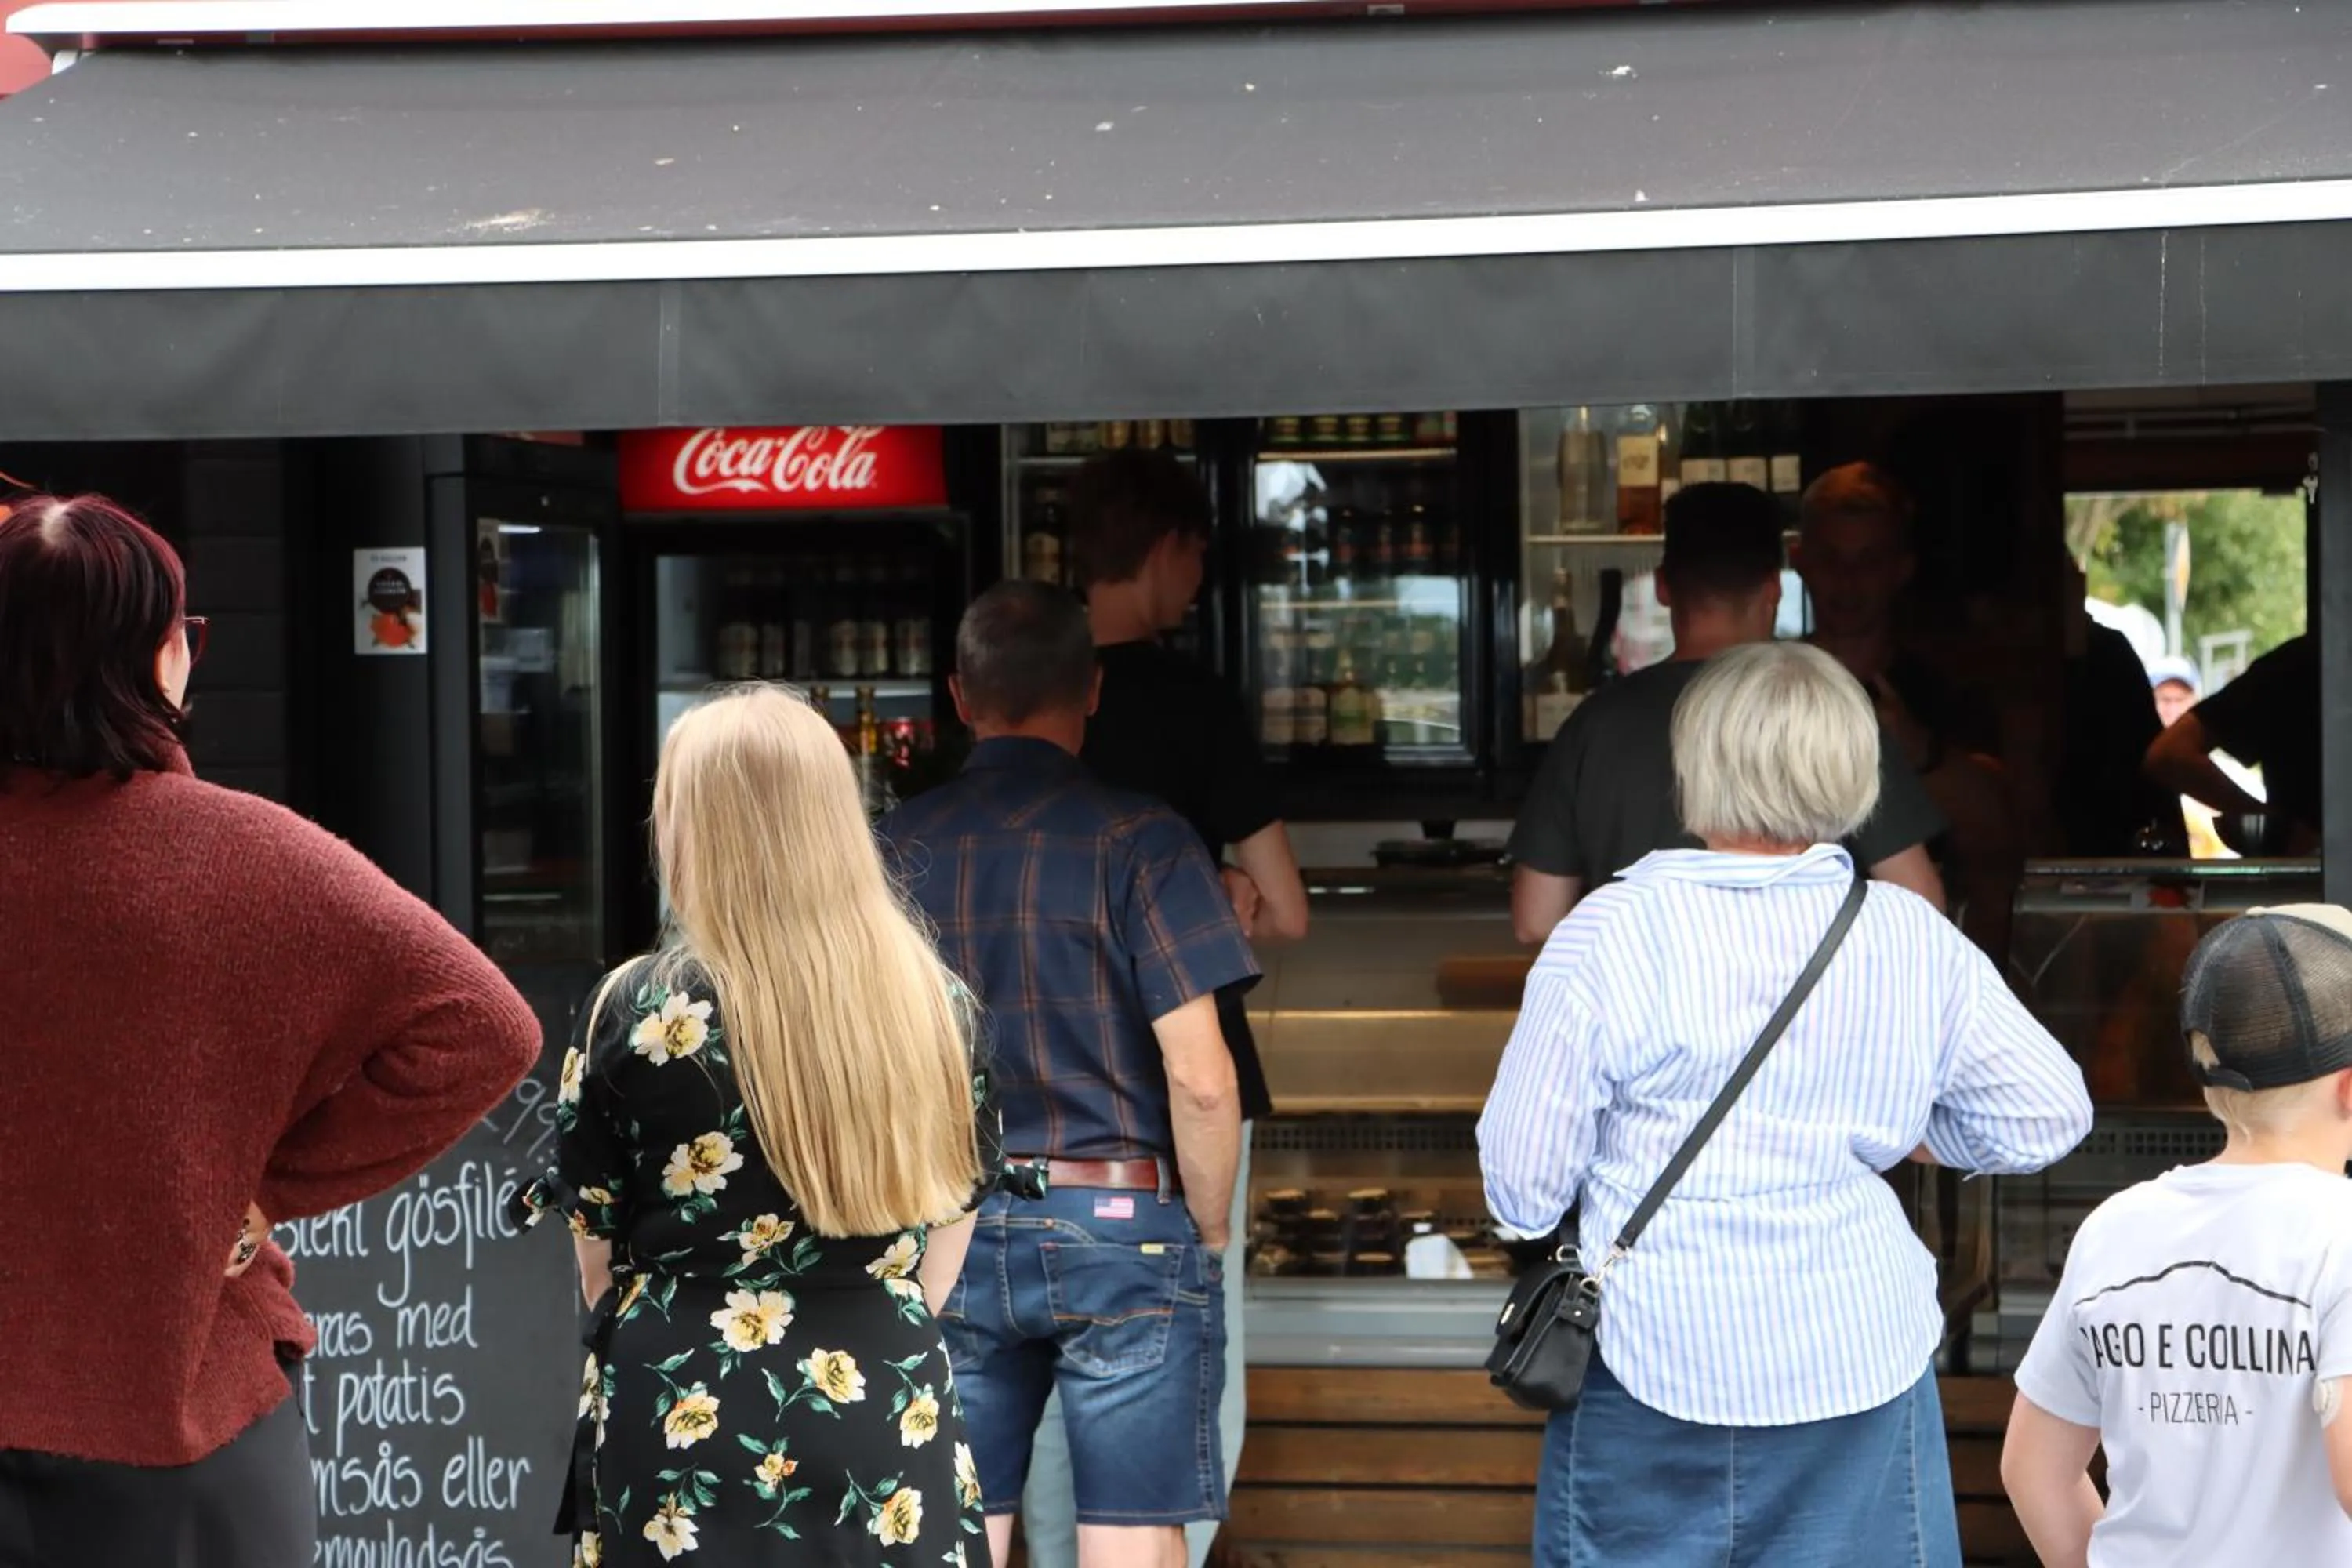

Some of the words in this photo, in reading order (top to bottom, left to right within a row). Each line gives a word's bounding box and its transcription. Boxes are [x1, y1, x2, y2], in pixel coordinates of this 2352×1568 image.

[673, 426, 884, 495] Coca-Cola
[396, 1284, 479, 1348] med
[2079, 1323, 2145, 1368] AGO
[2158, 1323, 2173, 1368] E
[2185, 1324, 2315, 1375] COLLINA
[336, 1358, 465, 1458] potatis
[441, 1435, 532, 1510] eller
